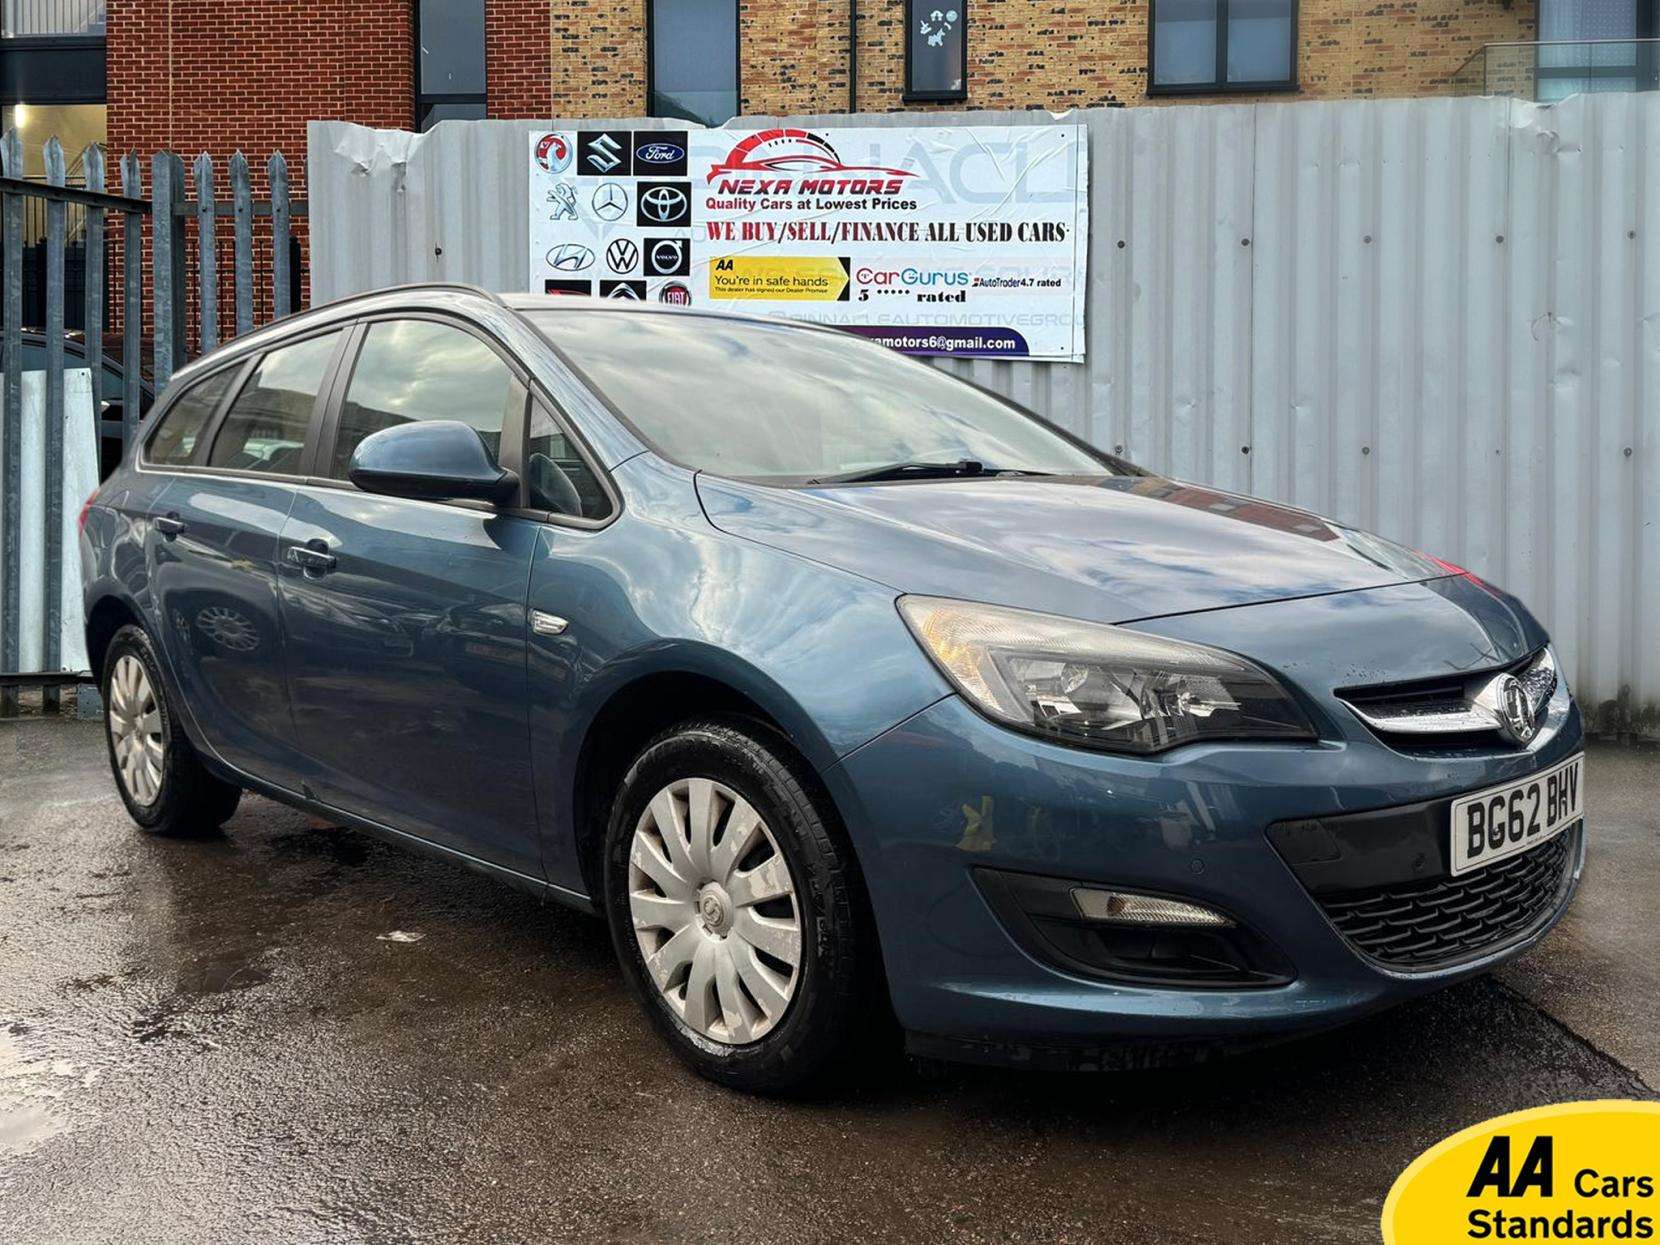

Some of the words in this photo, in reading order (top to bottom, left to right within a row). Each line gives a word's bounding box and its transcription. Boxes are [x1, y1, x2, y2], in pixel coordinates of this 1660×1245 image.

[645, 144, 675, 160] Ford
[717, 179, 792, 195] NEXA
[798, 179, 903, 195] MOTORS
[706, 198, 756, 212] Quality
[761, 198, 792, 210] Cars
[797, 199, 811, 210] at
[816, 198, 867, 210] Lowest
[872, 198, 917, 210] Prices
[706, 221, 735, 241] WE
[925, 222, 960, 242] ALL
[965, 222, 1012, 242] USED
[1017, 222, 1065, 242] CARS
[716, 259, 734, 271] AA
[715, 275, 750, 286] You're
[753, 276, 763, 285] in
[766, 276, 792, 286] safe
[793, 276, 828, 287] hands
[856, 268, 969, 286] CarGurus
[1020, 278, 1035, 287] 4.7
[1037, 278, 1061, 287] rated
[667, 291, 685, 305] FIAT
[858, 289, 869, 301] 5
[917, 290, 966, 302] rated
[1467, 783, 1541, 859] BG62
[1547, 762, 1578, 827] BHV
